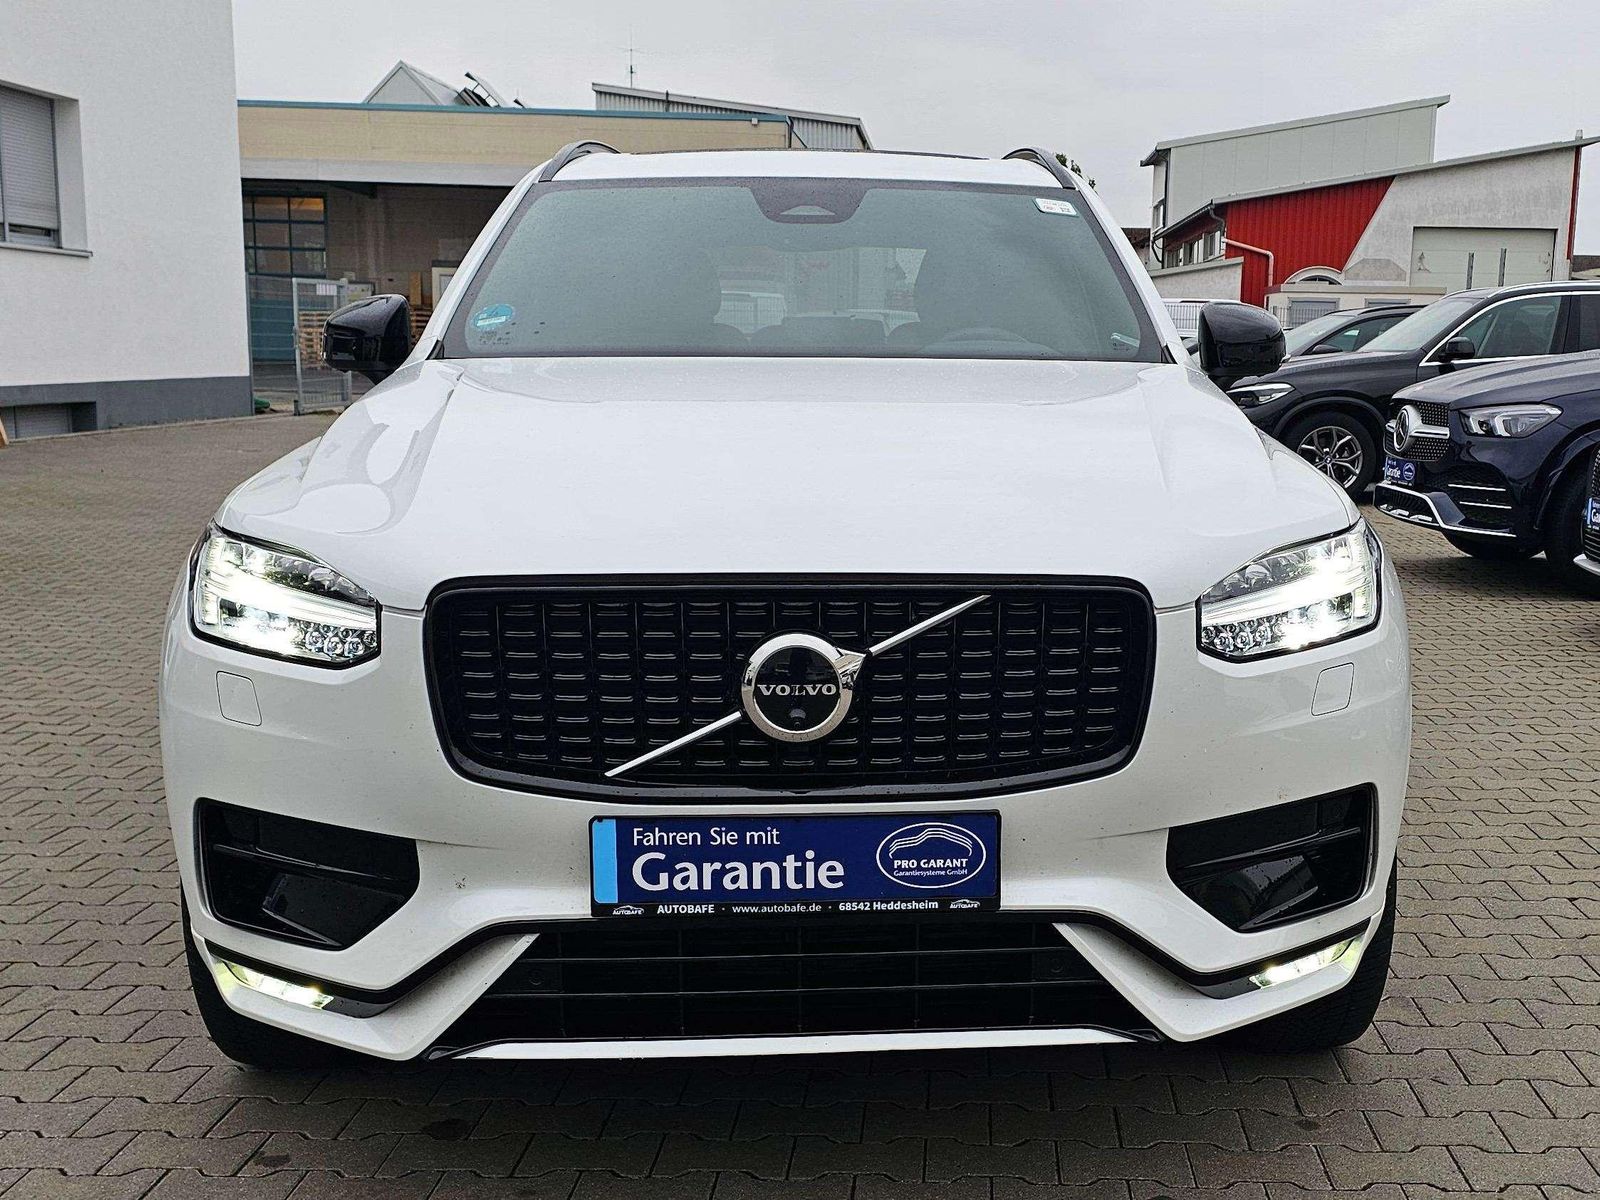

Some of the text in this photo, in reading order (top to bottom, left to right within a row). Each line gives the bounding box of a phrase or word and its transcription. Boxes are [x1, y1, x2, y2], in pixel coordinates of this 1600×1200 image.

[757, 683, 837, 696] VOLVO
[633, 826, 780, 846] Fahren Sie mit
[893, 858, 968, 869] PRO GARANT
[632, 850, 845, 891] Garantie
[893, 869, 946, 877] Garantiesysteme
[657, 900, 939, 914] AUTOBAFE www.autobafe.de 68542 Heddesheim
